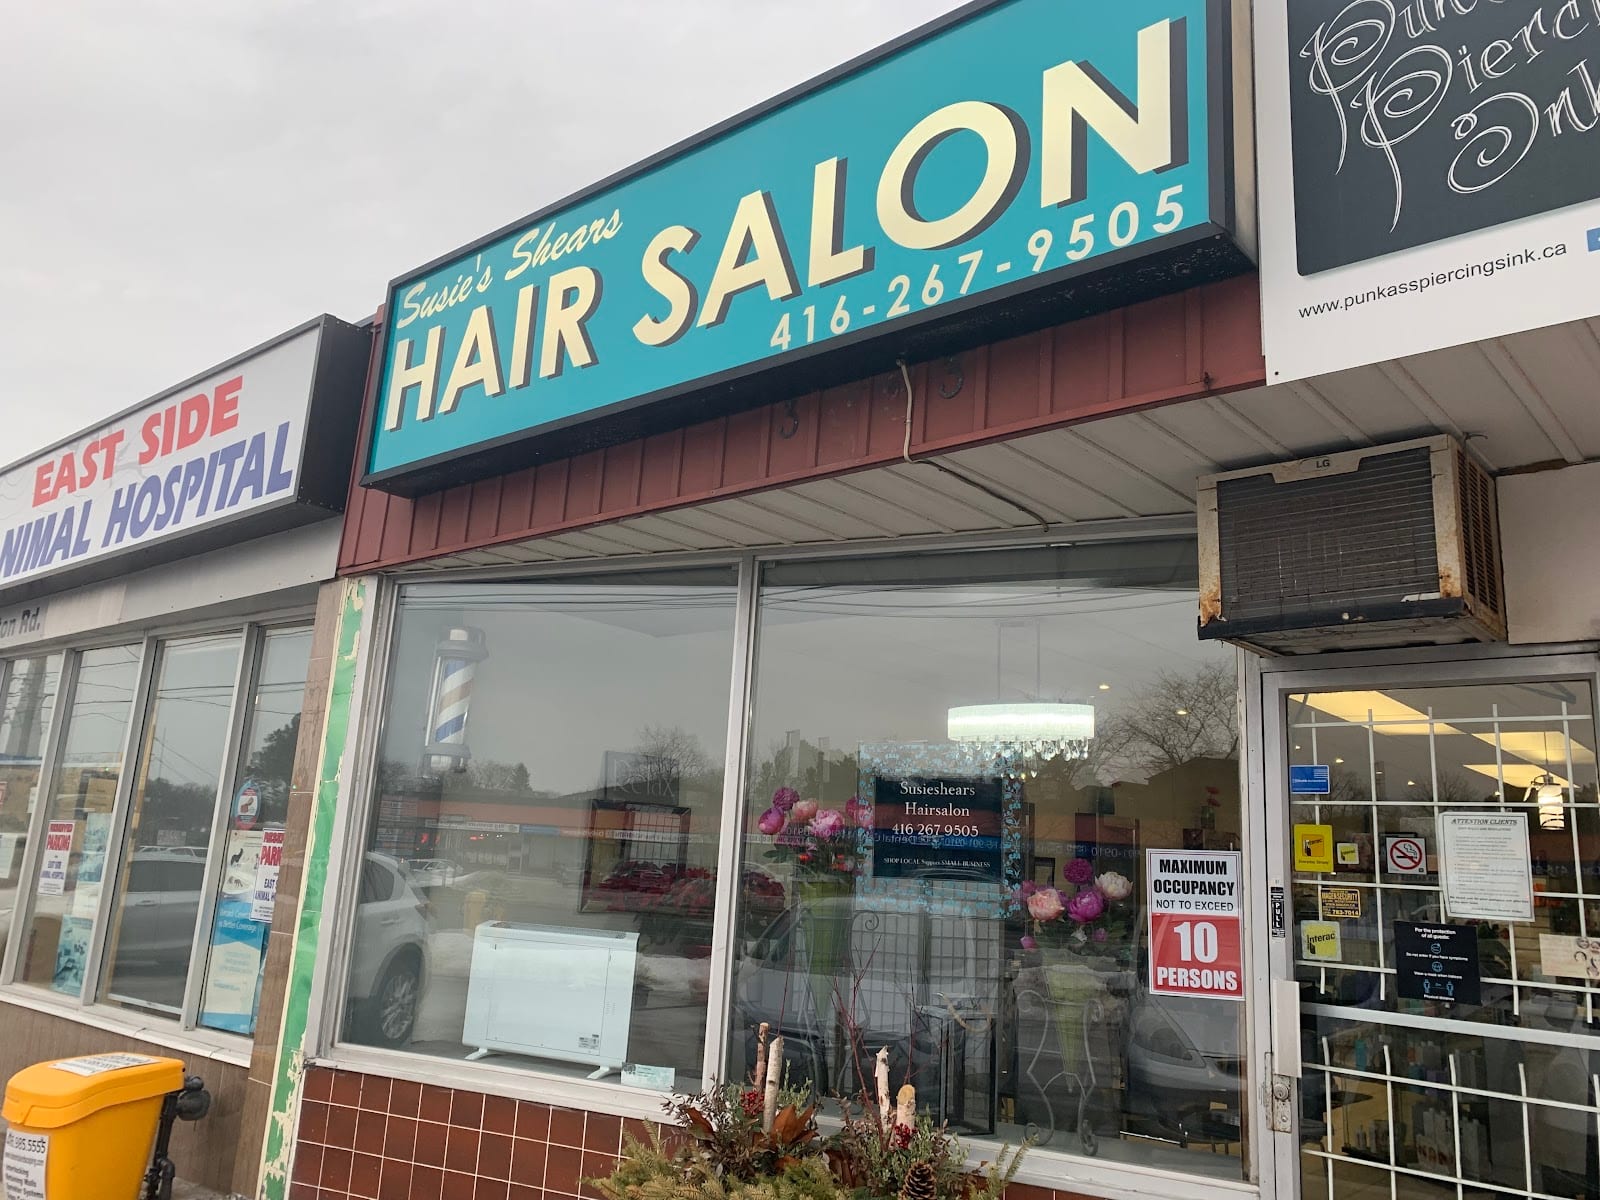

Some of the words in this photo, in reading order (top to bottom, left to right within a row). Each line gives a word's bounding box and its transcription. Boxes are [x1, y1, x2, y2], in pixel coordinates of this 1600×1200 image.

[1350, 0, 1600, 233] Pierc
[384, 265, 603, 432] HAIR
[632, 16, 1188, 347] SALON
[397, 254, 493, 329] Susie's
[505, 209, 623, 281] Shears
[770, 184, 1184, 351] 416-267-9505
[1298, 243, 1567, 319] www.punkasspiercingsink.ca
[32, 429, 125, 508] EAST
[138, 375, 243, 465] SIDE
[1316, 459, 1330, 469] LG
[101, 421, 293, 548] HOSPITAL
[900, 781, 976, 796] Susieshears
[904, 801, 970, 817] Hairsalon
[891, 823, 914, 836] 416
[917, 824, 941, 836] 267
[944, 825, 979, 838] 9505
[1159, 859, 1227, 875] MAXIMUM
[1153, 879, 1235, 896] OCCUPANCY
[1156, 899, 1175, 909] NOT
[1178, 900, 1192, 909] TO
[1195, 900, 1234, 911] EXCEED
[1174, 921, 1218, 963] 10
[1157, 966, 1238, 991] PERSONS
